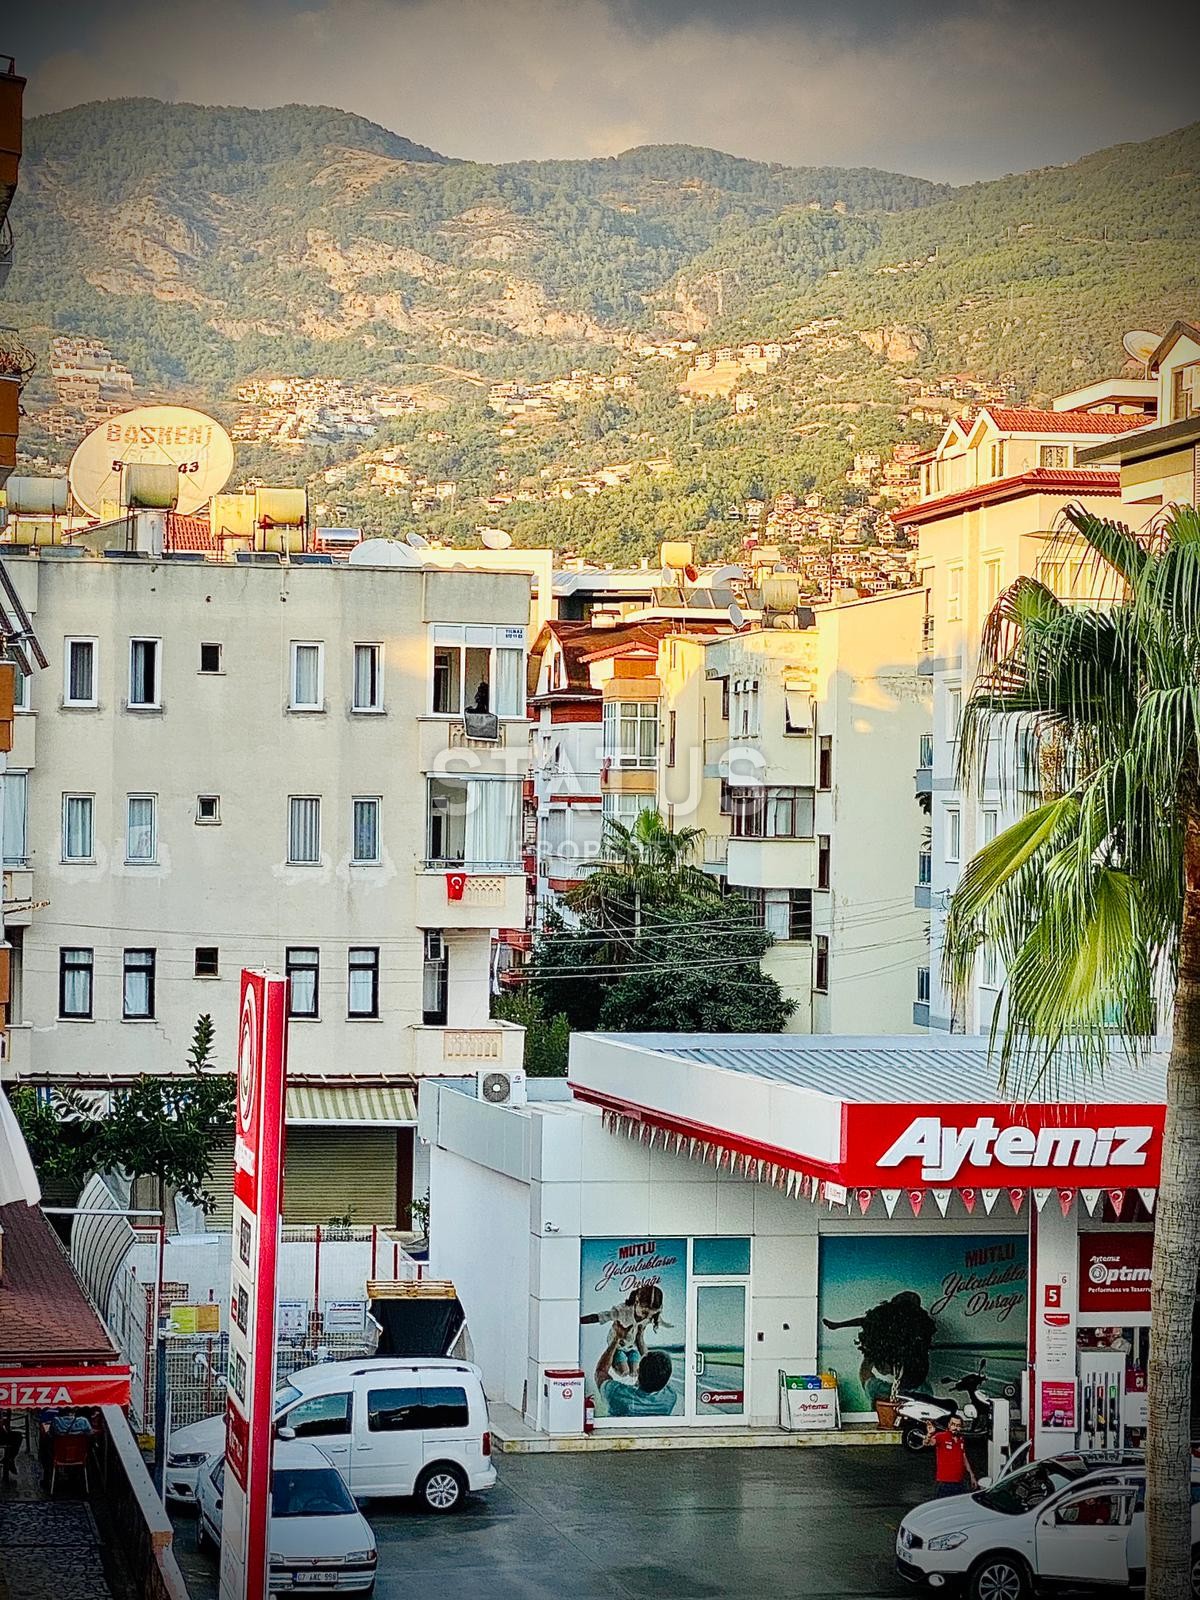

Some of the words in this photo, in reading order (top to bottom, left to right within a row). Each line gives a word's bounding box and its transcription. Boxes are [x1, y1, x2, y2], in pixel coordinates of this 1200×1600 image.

[875, 1116, 1154, 1182] Aytemiz
[1089, 1255, 1121, 1263] Aytemiz
[1061, 1276, 1067, 1284] 6
[1048, 1289, 1058, 1302] 5
[798, 1403, 829, 1412] Aytemiz
